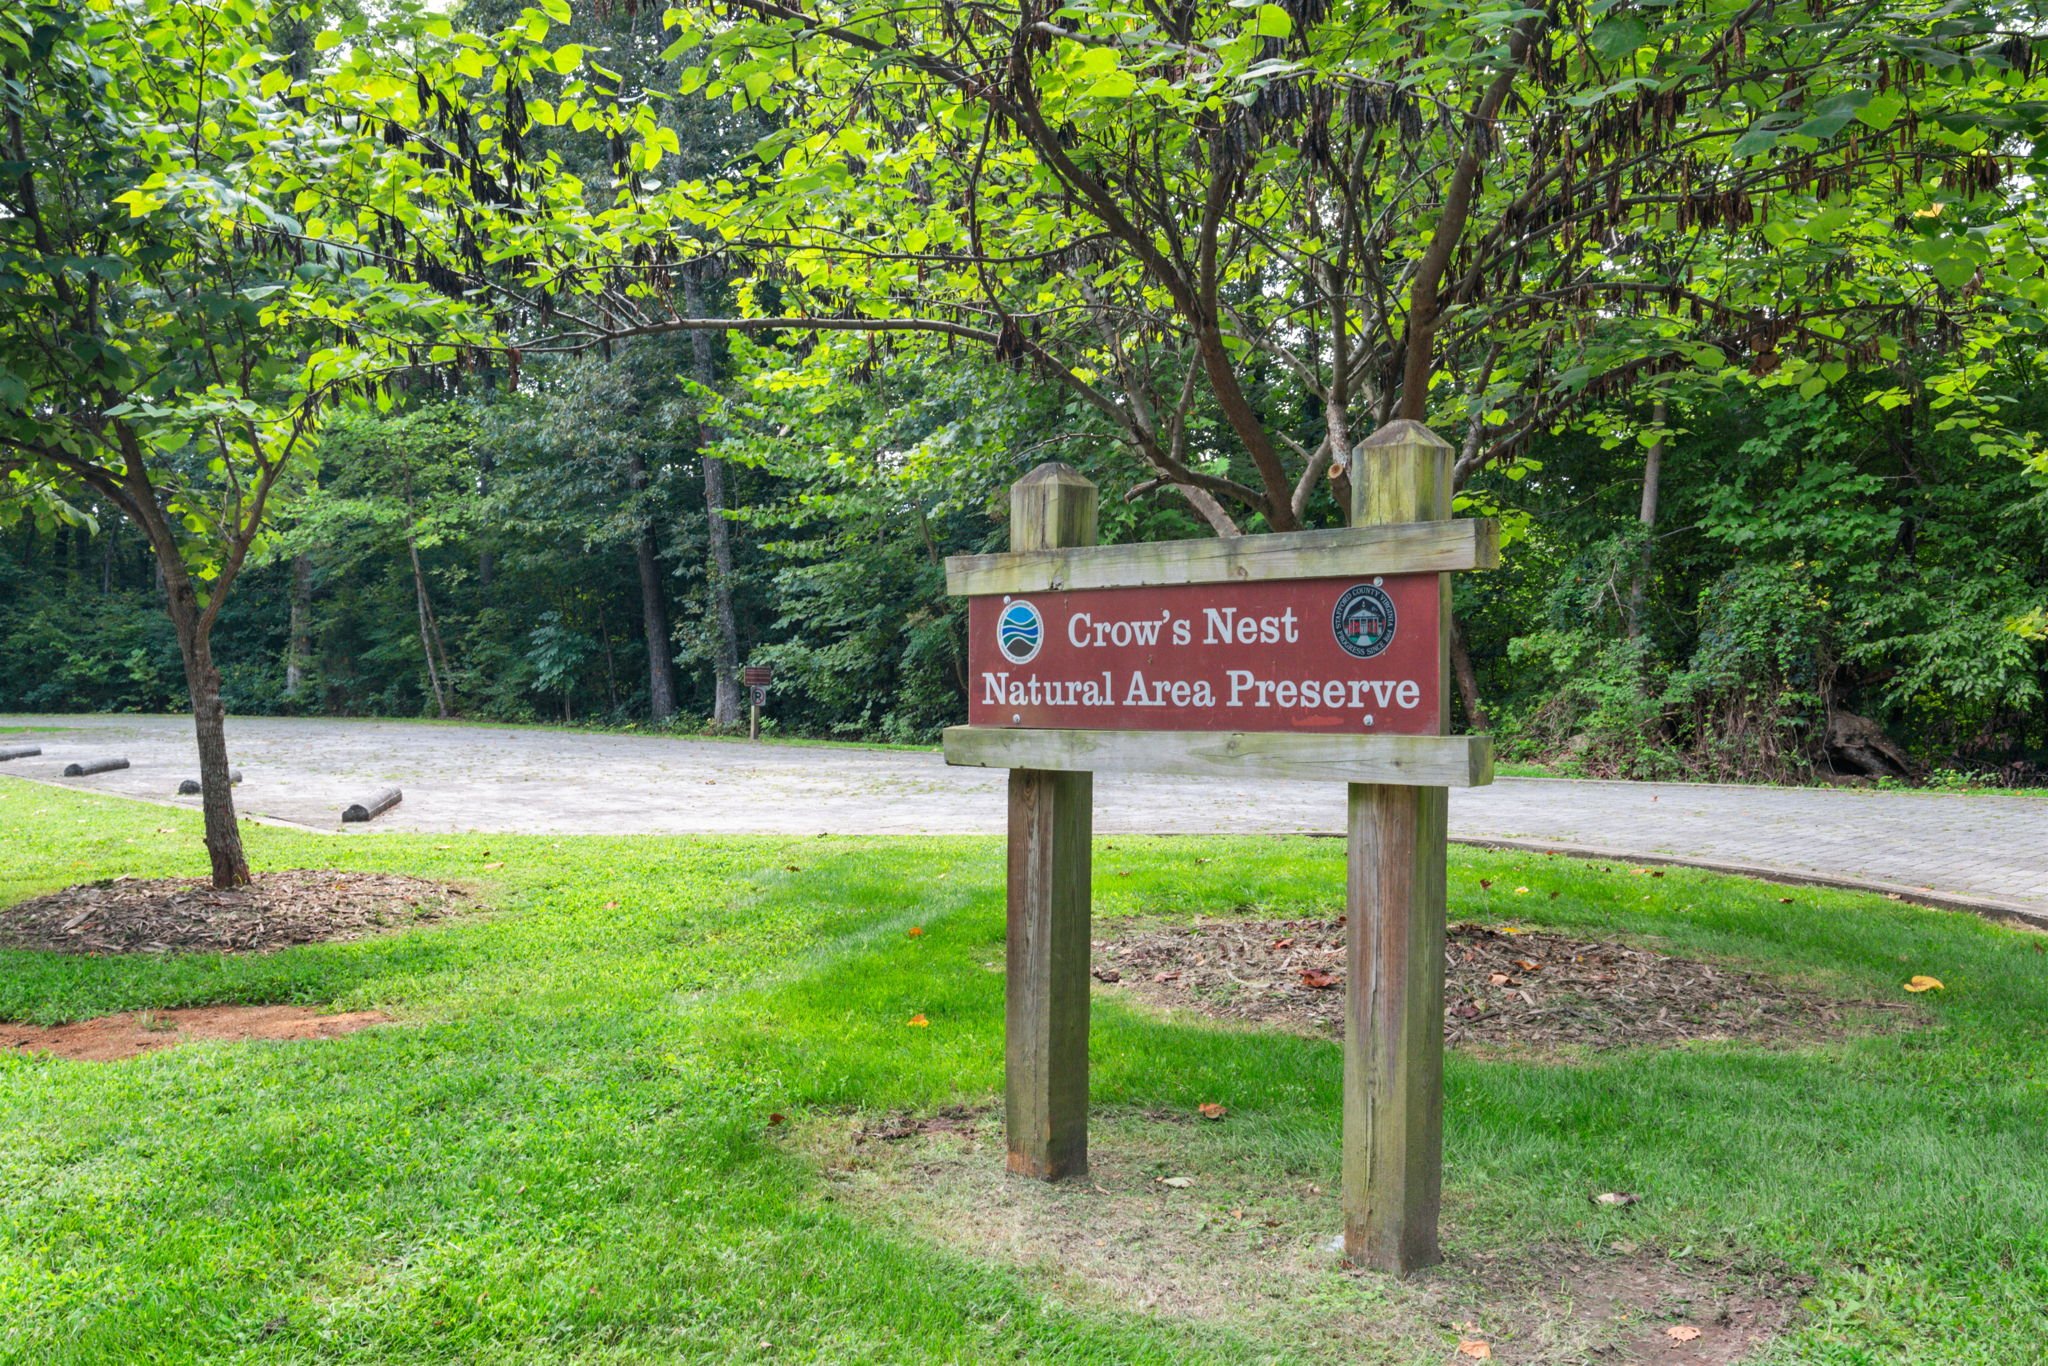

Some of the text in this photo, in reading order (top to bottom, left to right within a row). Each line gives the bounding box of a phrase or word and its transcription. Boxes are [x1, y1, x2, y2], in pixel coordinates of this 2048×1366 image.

[1067, 609, 1192, 648] Crow's
[1202, 606, 1299, 645] Nest
[1335, 588, 1394, 629] STAFFORD COUNTY VIRGINIA
[1337, 631, 1366, 655] PROGRESS
[1366, 640, 1386, 655] SINCE
[981, 670, 1420, 709] Natural Area Preserve
